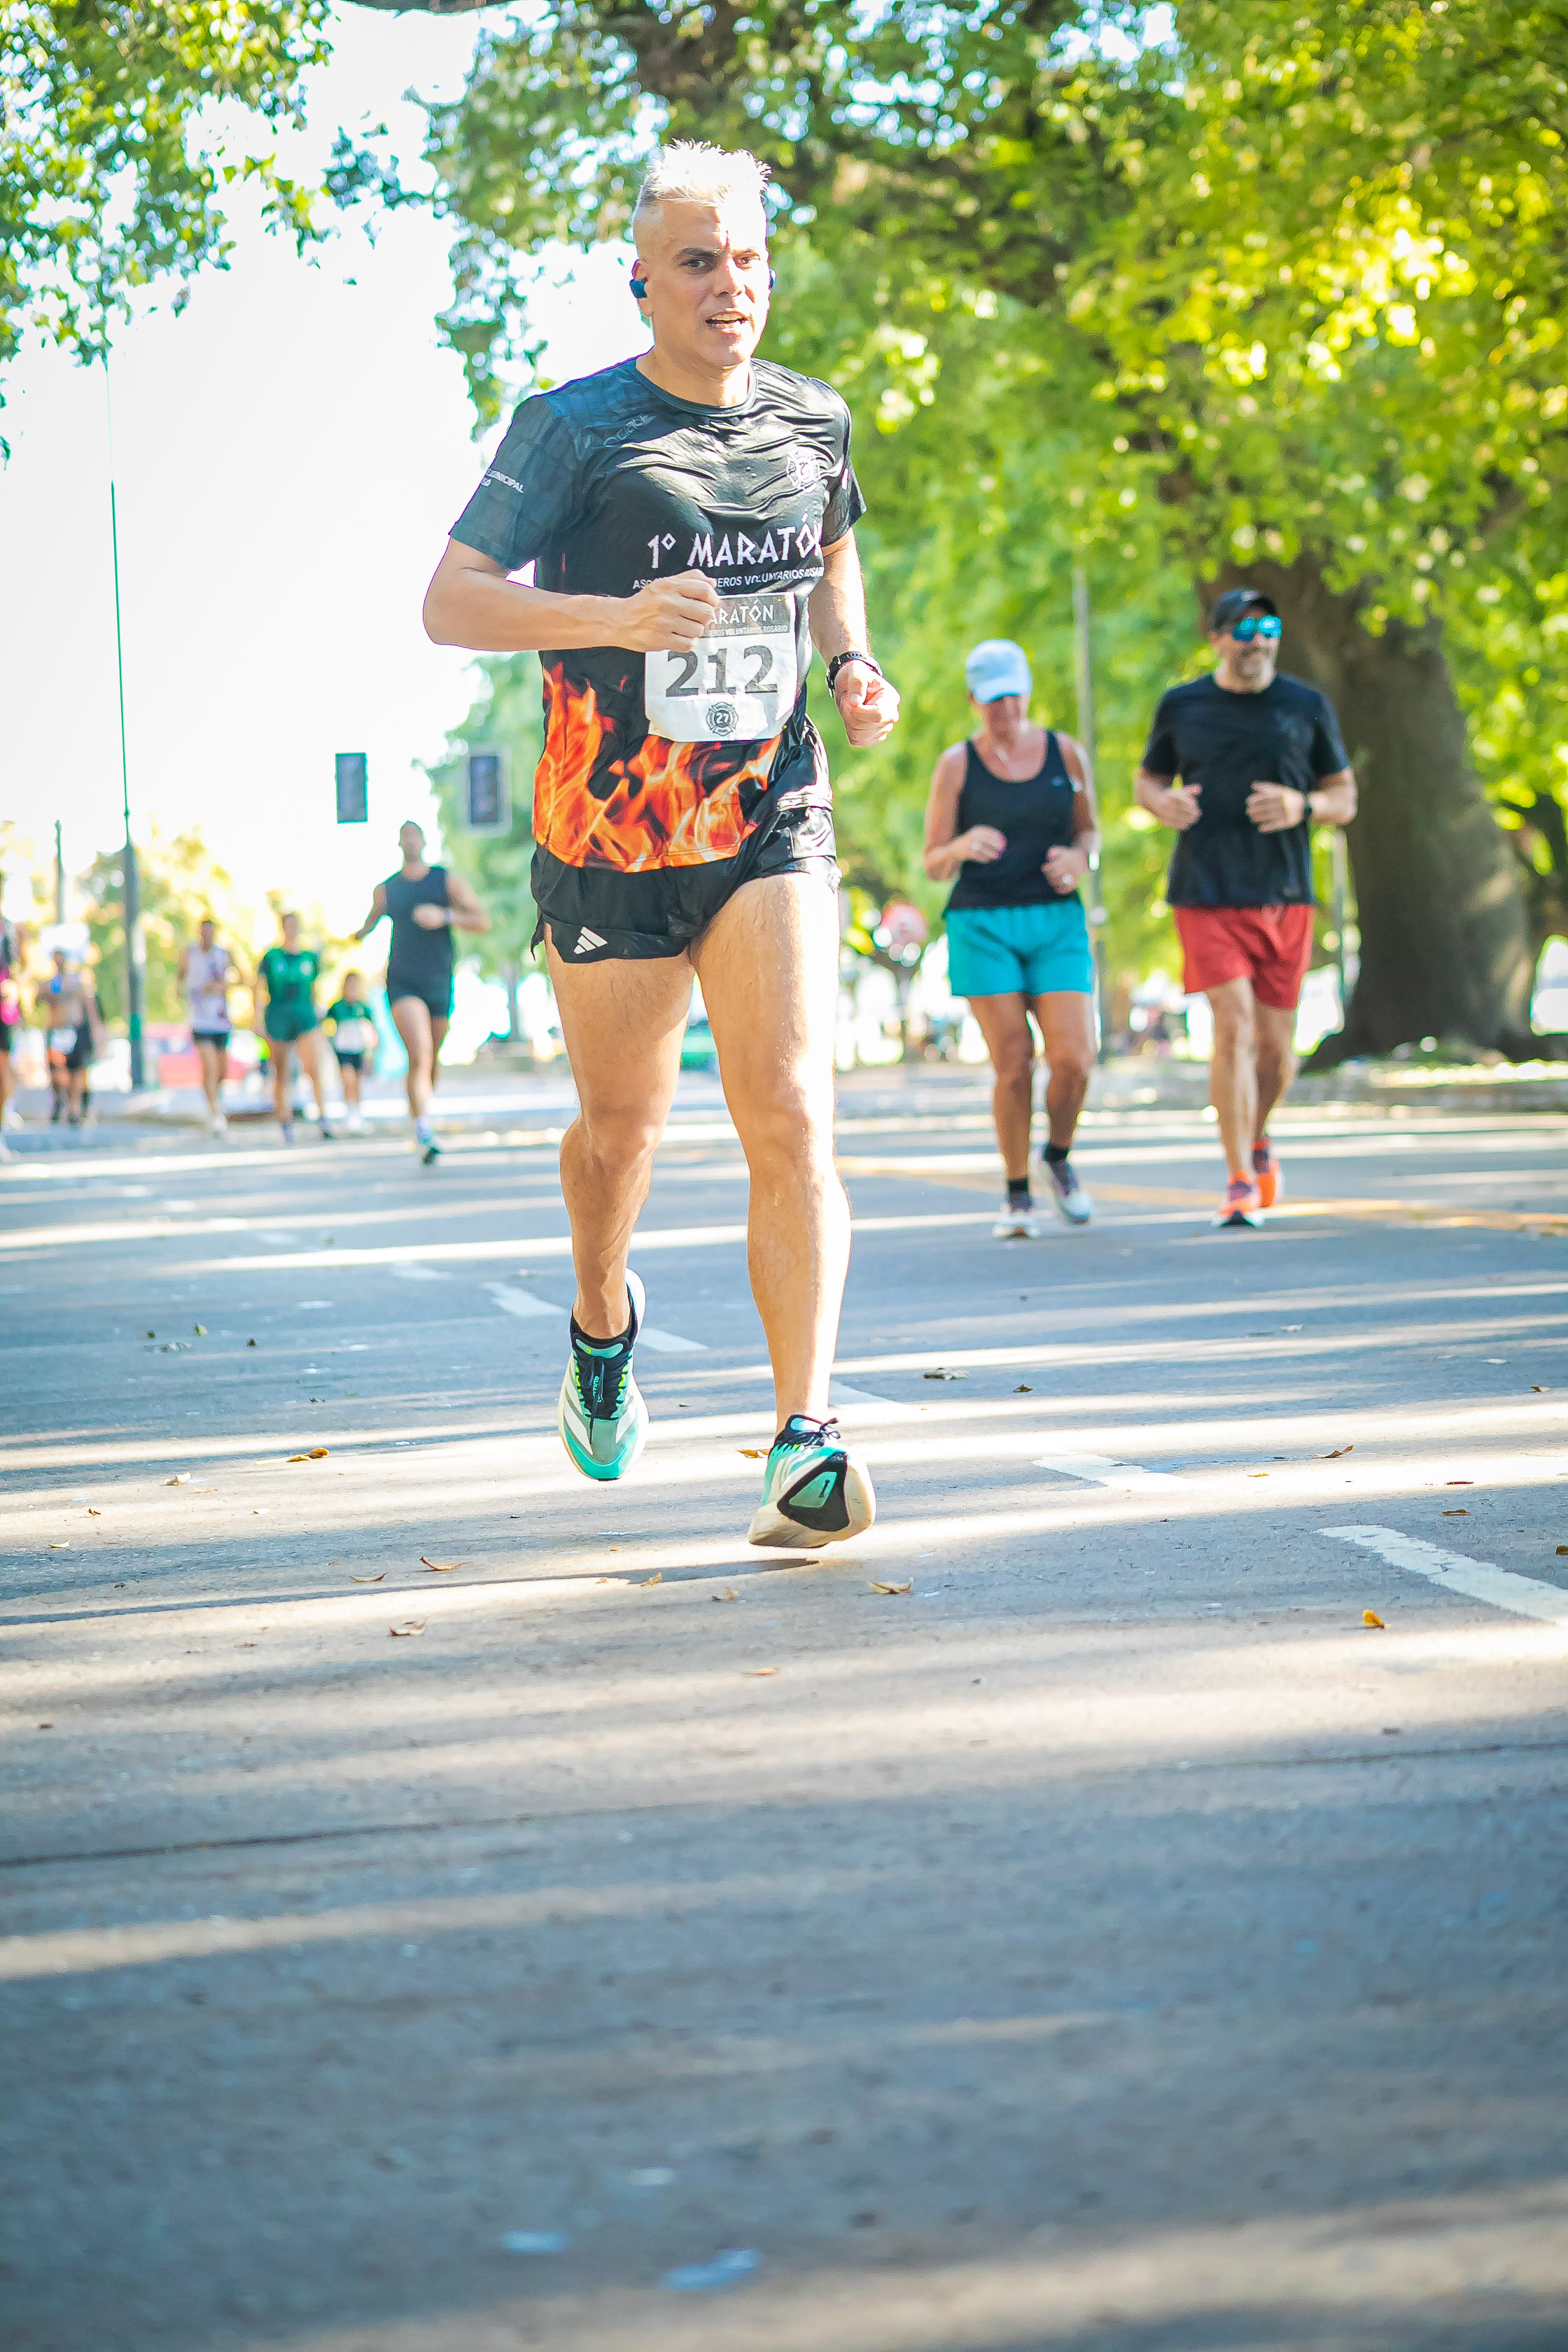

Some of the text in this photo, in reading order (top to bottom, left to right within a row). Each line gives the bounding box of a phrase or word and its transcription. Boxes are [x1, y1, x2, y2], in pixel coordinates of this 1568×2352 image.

[687, 512, 822, 568] MARATÓN
[714, 576, 743, 587] EROS
[707, 600, 774, 625] ARATÓN
[763, 624, 788, 633] ROSARIO
[666, 645, 778, 698] 212
[715, 712, 729, 724] 27
